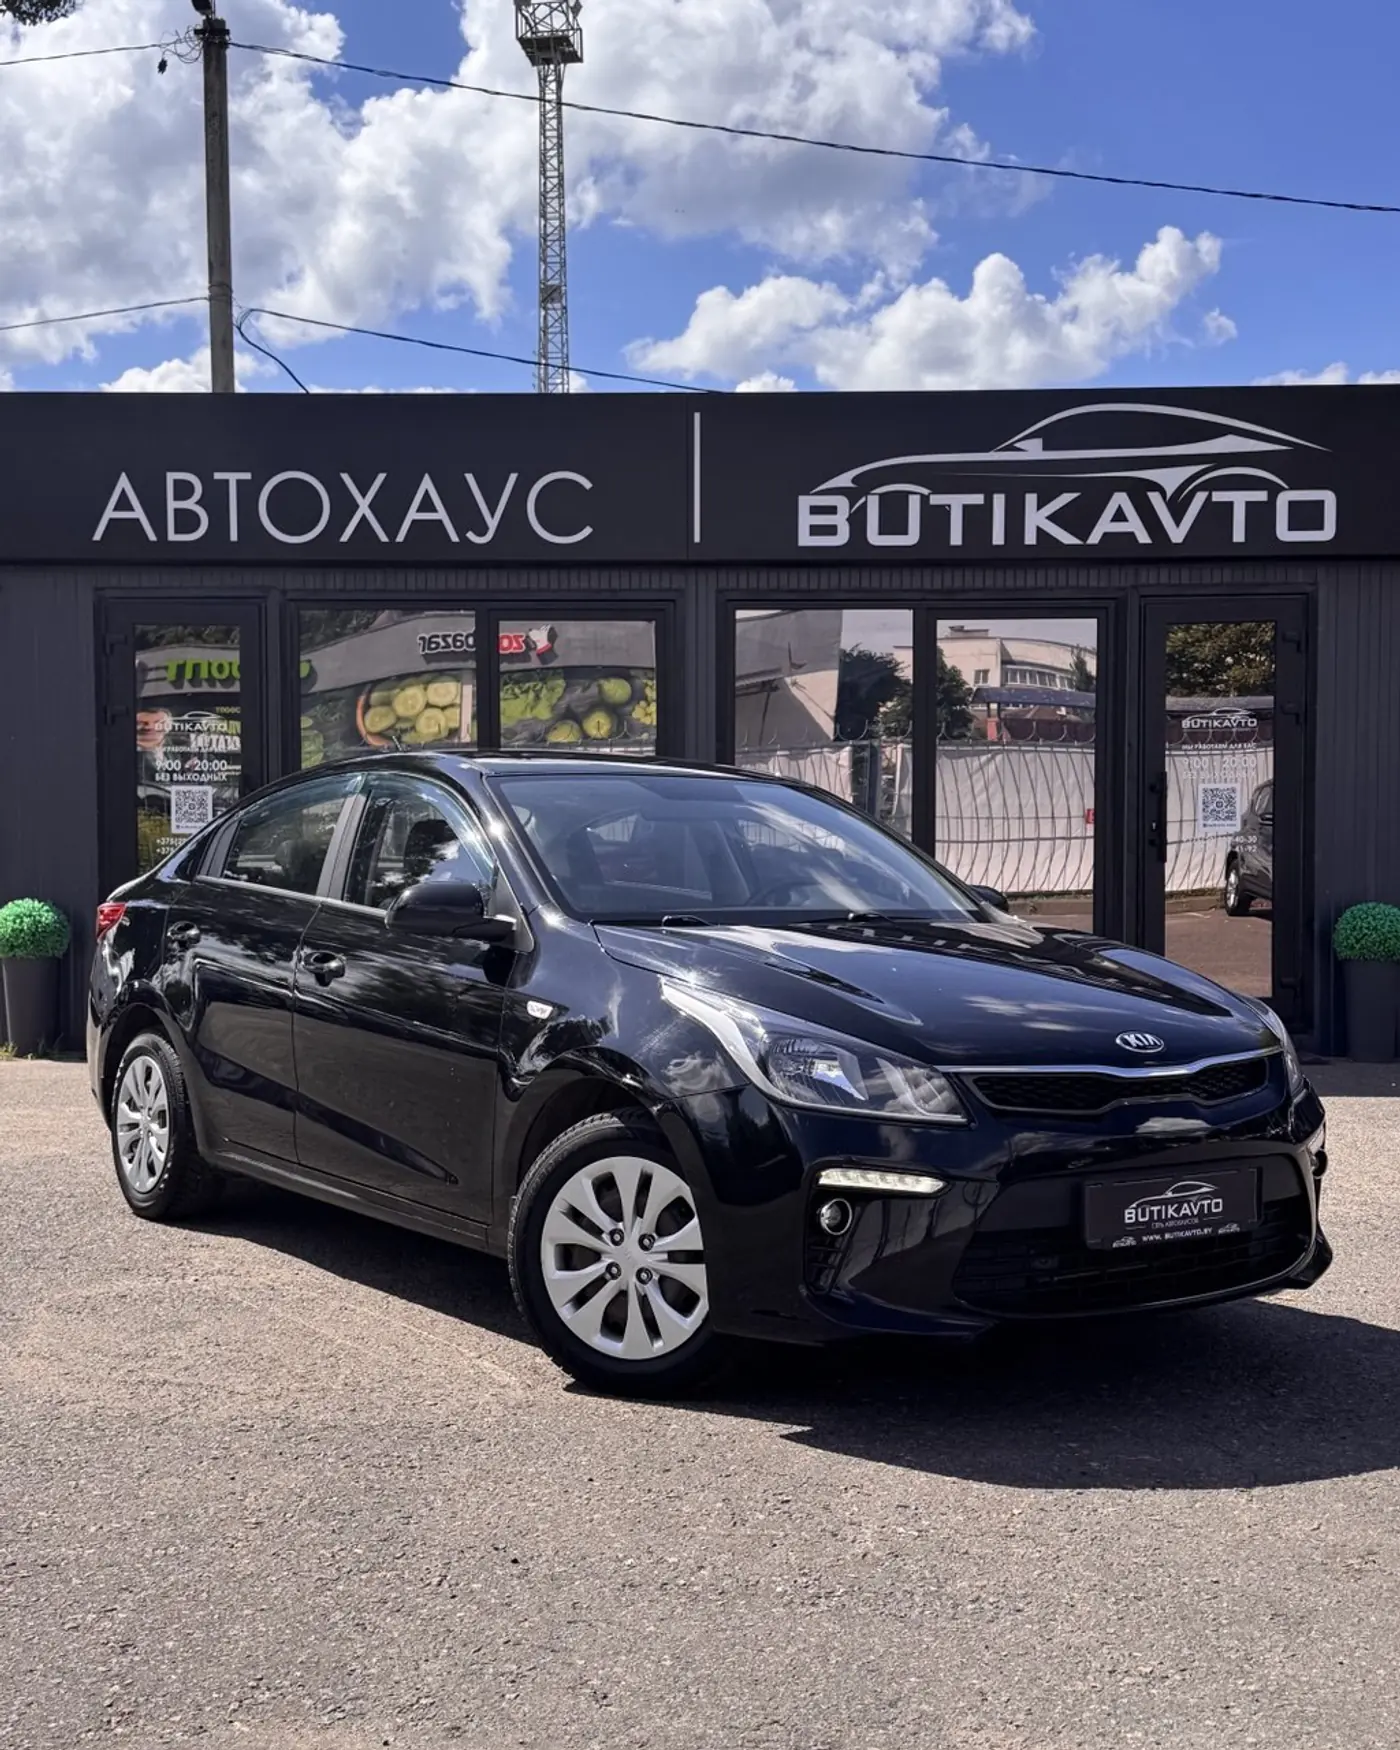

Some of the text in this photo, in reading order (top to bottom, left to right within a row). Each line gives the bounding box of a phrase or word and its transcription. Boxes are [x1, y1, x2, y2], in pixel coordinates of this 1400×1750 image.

[92, 471, 595, 545] АВТОХАУС
[797, 488, 1338, 547] BUTIKAVTO
[155, 721, 228, 732] BUTIKAVTO
[1181, 718, 1257, 728] BUTIKAVTO
[155, 760, 181, 771] 9:00
[194, 760, 228, 771] 20:00
[155, 772, 228, 781] БЕЗ ВЫХОДНЫХ
[1125, 1034, 1161, 1049] KIA
[1124, 1198, 1224, 1224] BUTIKAVTO
